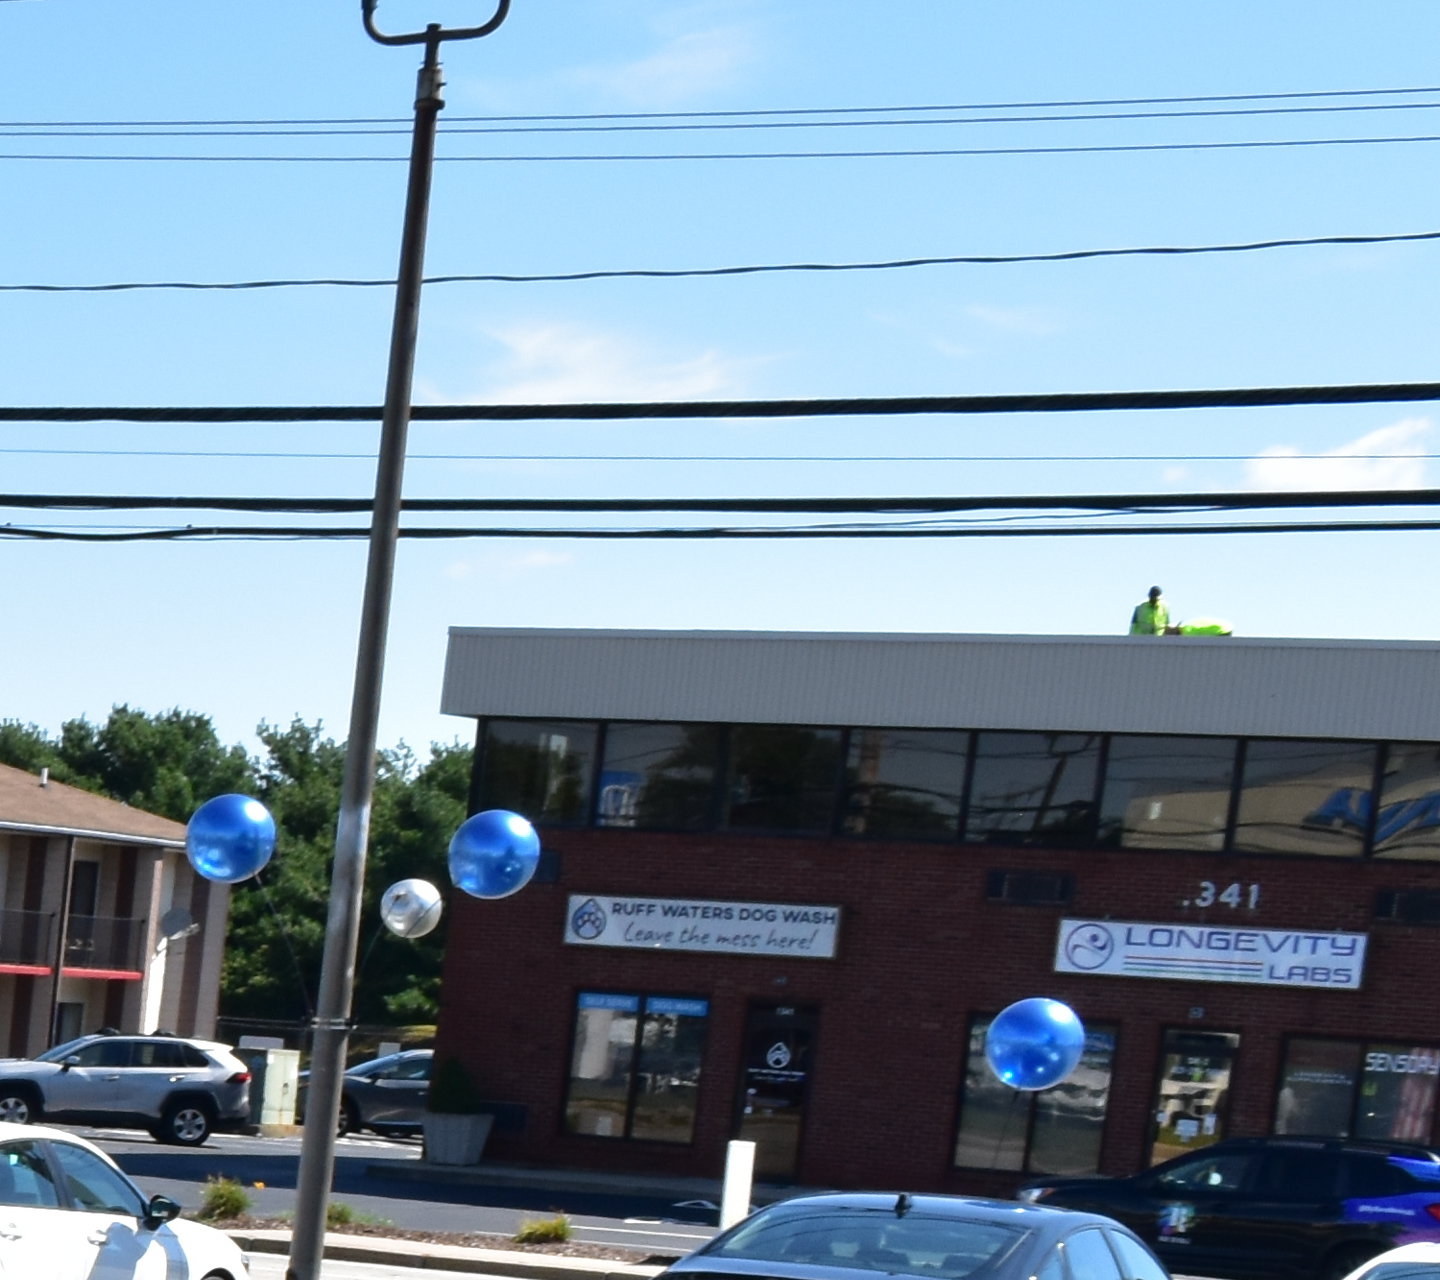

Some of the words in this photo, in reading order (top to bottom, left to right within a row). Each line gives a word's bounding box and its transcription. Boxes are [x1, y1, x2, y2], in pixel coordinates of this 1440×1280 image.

[611, 902, 657, 916] RUFF
[662, 904, 733, 920] WATERS
[738, 907, 778, 922] DOG
[782, 909, 837, 925] WASH
[623, 921, 673, 942] Leave
[679, 924, 710, 944] the
[715, 932, 761, 948] mess
[766, 927, 820, 950] here!
[1125, 926, 1358, 957] LONGEVITY
[1267, 965, 1353, 984] LABS
